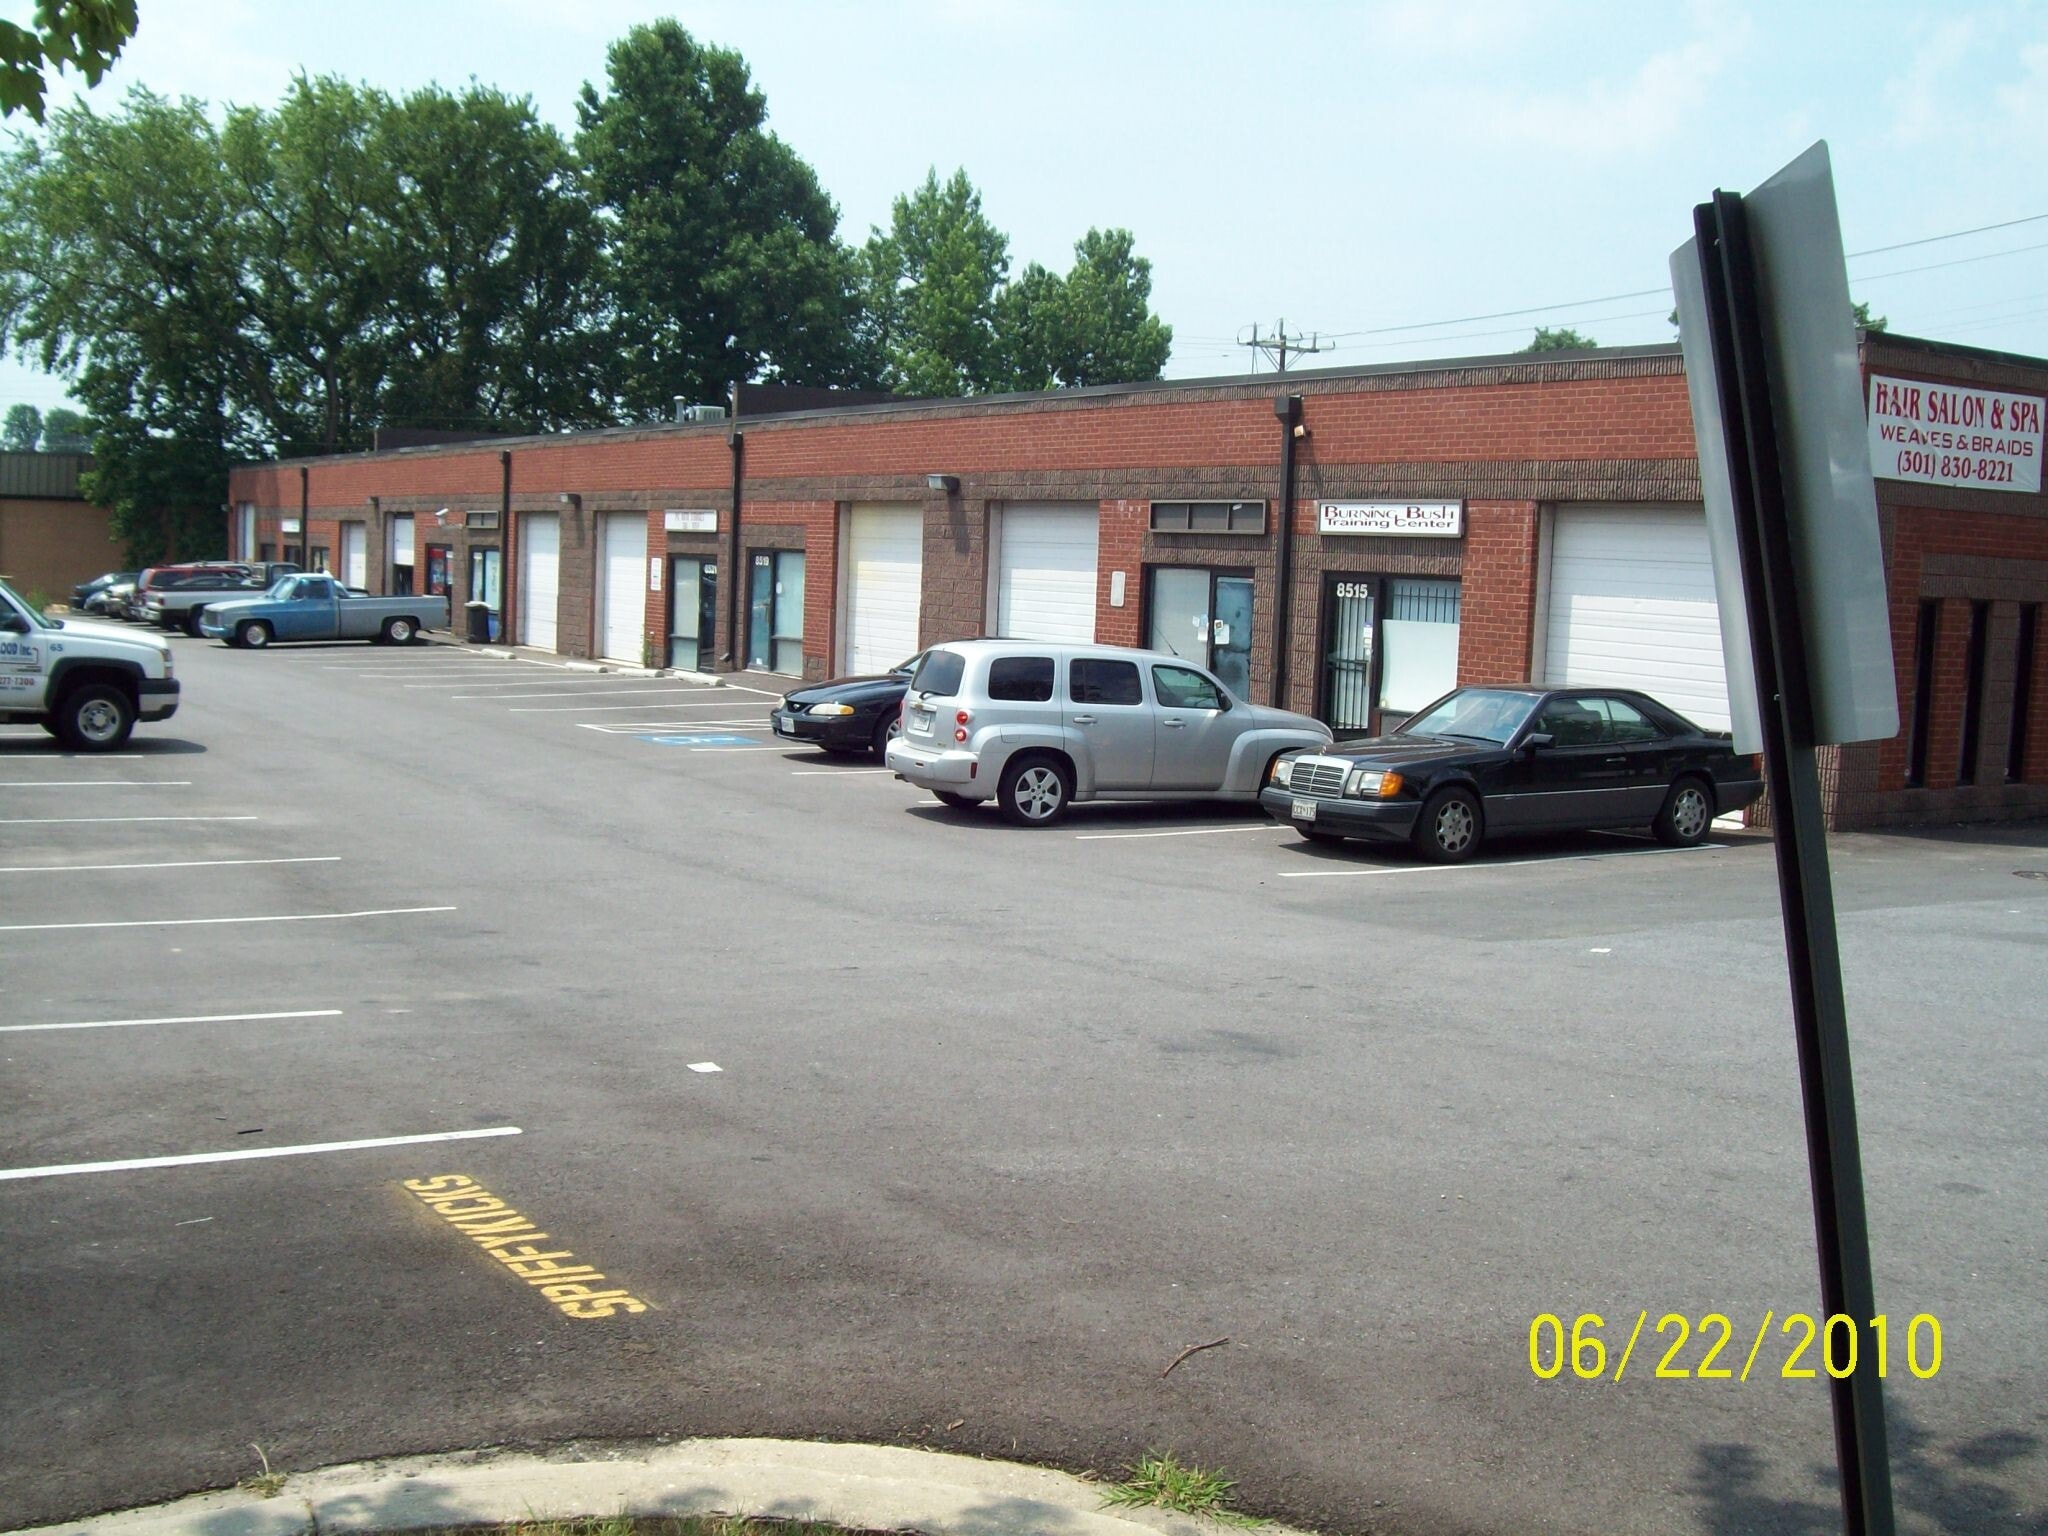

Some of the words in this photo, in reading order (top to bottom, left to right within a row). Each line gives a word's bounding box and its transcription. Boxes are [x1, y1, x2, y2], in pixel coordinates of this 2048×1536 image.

[1875, 382, 1921, 421] HAIR
[1928, 390, 1985, 428] SALON
[1990, 398, 2005, 430] &
[2010, 401, 2040, 434] SPA
[1880, 423, 1953, 449] WEAVES
[1956, 434, 1969, 451] &
[1972, 435, 2033, 457] BRAIDS
[1897, 450, 1936, 480] (301)
[1940, 456, 2014, 483] 830-8221
[1326, 518, 1390, 529] Training
[1395, 516, 1455, 529] Center
[1336, 582, 1368, 599] 8515
